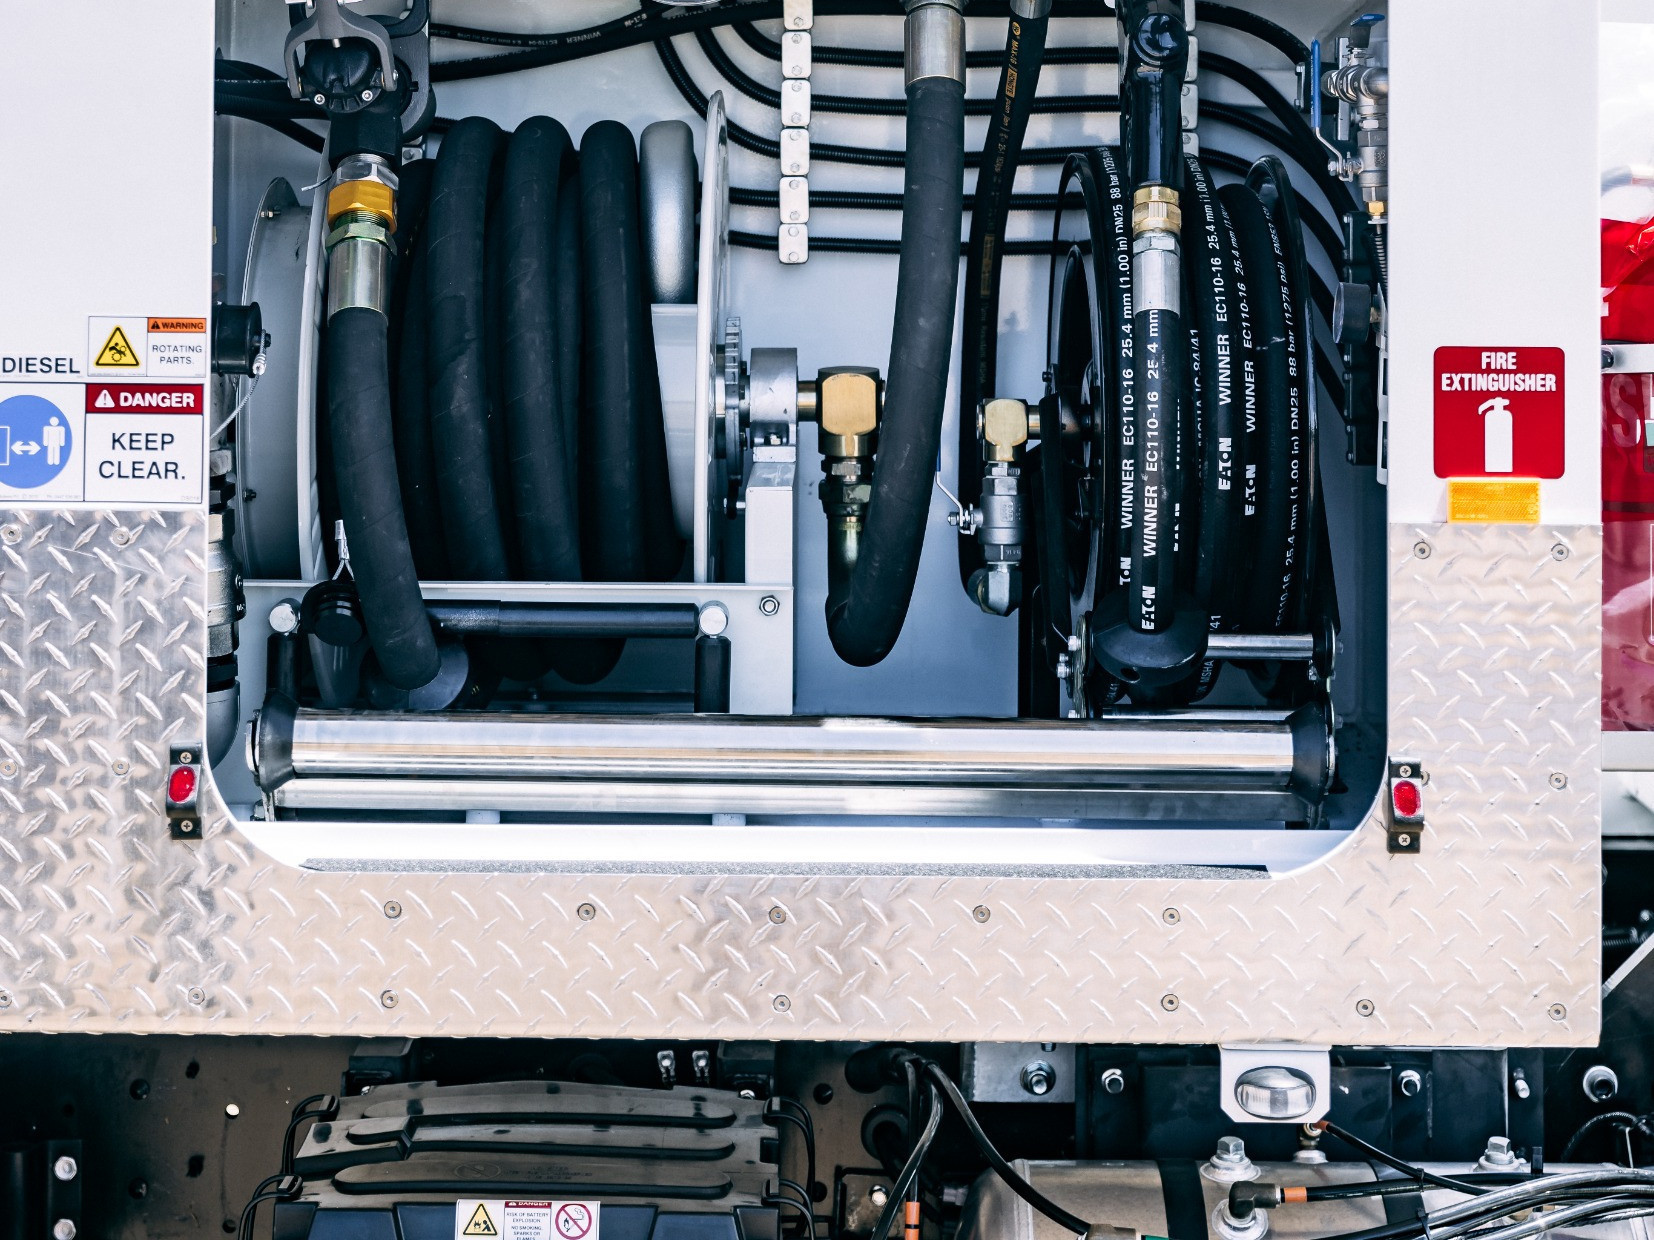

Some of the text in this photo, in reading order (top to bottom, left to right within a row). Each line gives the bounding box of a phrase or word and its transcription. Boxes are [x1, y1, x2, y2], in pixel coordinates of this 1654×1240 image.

[566, 31, 601, 44] WINNER
[1109, 174, 1117, 187] bar
[1110, 187, 1121, 199] 88
[1113, 204, 1124, 234] DN25
[1205, 204, 1215, 223] mm
[1116, 236, 1128, 251] in)
[1206, 223, 1220, 250] 25.4
[1228, 230, 1239, 249] mm
[1119, 254, 1131, 289] (1.00
[1231, 249, 1244, 276] 25.4
[1277, 261, 1288, 284] psi)
[1211, 257, 1228, 322] EC110-16
[1122, 293, 1132, 319] mm
[1237, 282, 1253, 349] EC110-16
[1281, 285, 1295, 326] (1275
[162, 322, 204, 330] WARNING
[1149, 310, 1158, 337] mm
[152, 345, 202, 353] ROTATING
[1122, 323, 1133, 358] 25.4
[1287, 329, 1296, 353] bar
[2, 356, 80, 374] DIESEL
[1147, 342, 1159, 379] 254
[1217, 333, 1232, 406] WINNER
[1288, 357, 1298, 377] 88
[1481, 351, 1517, 370] FIRE
[1441, 373, 1557, 392] EXTINGUISHER
[119, 392, 195, 408] DANGER
[1122, 368, 1134, 446] EC110-16
[1244, 360, 1256, 433] WINNER
[1290, 387, 1299, 430] DN25
[112, 432, 174, 451] KEEP
[1146, 391, 1158, 471] EC110-16
[1291, 436, 1300, 455] in)
[99, 460, 185, 480] CLEAR.
[1218, 437, 1232, 491] EATON
[1290, 459, 1299, 499] (1.00
[1120, 459, 1134, 529] WINNER
[1143, 485, 1158, 558] WINNER
[1290, 504, 1298, 531] mm
[1285, 535, 1295, 566] 25.4
[1119, 556, 1131, 586] TON
